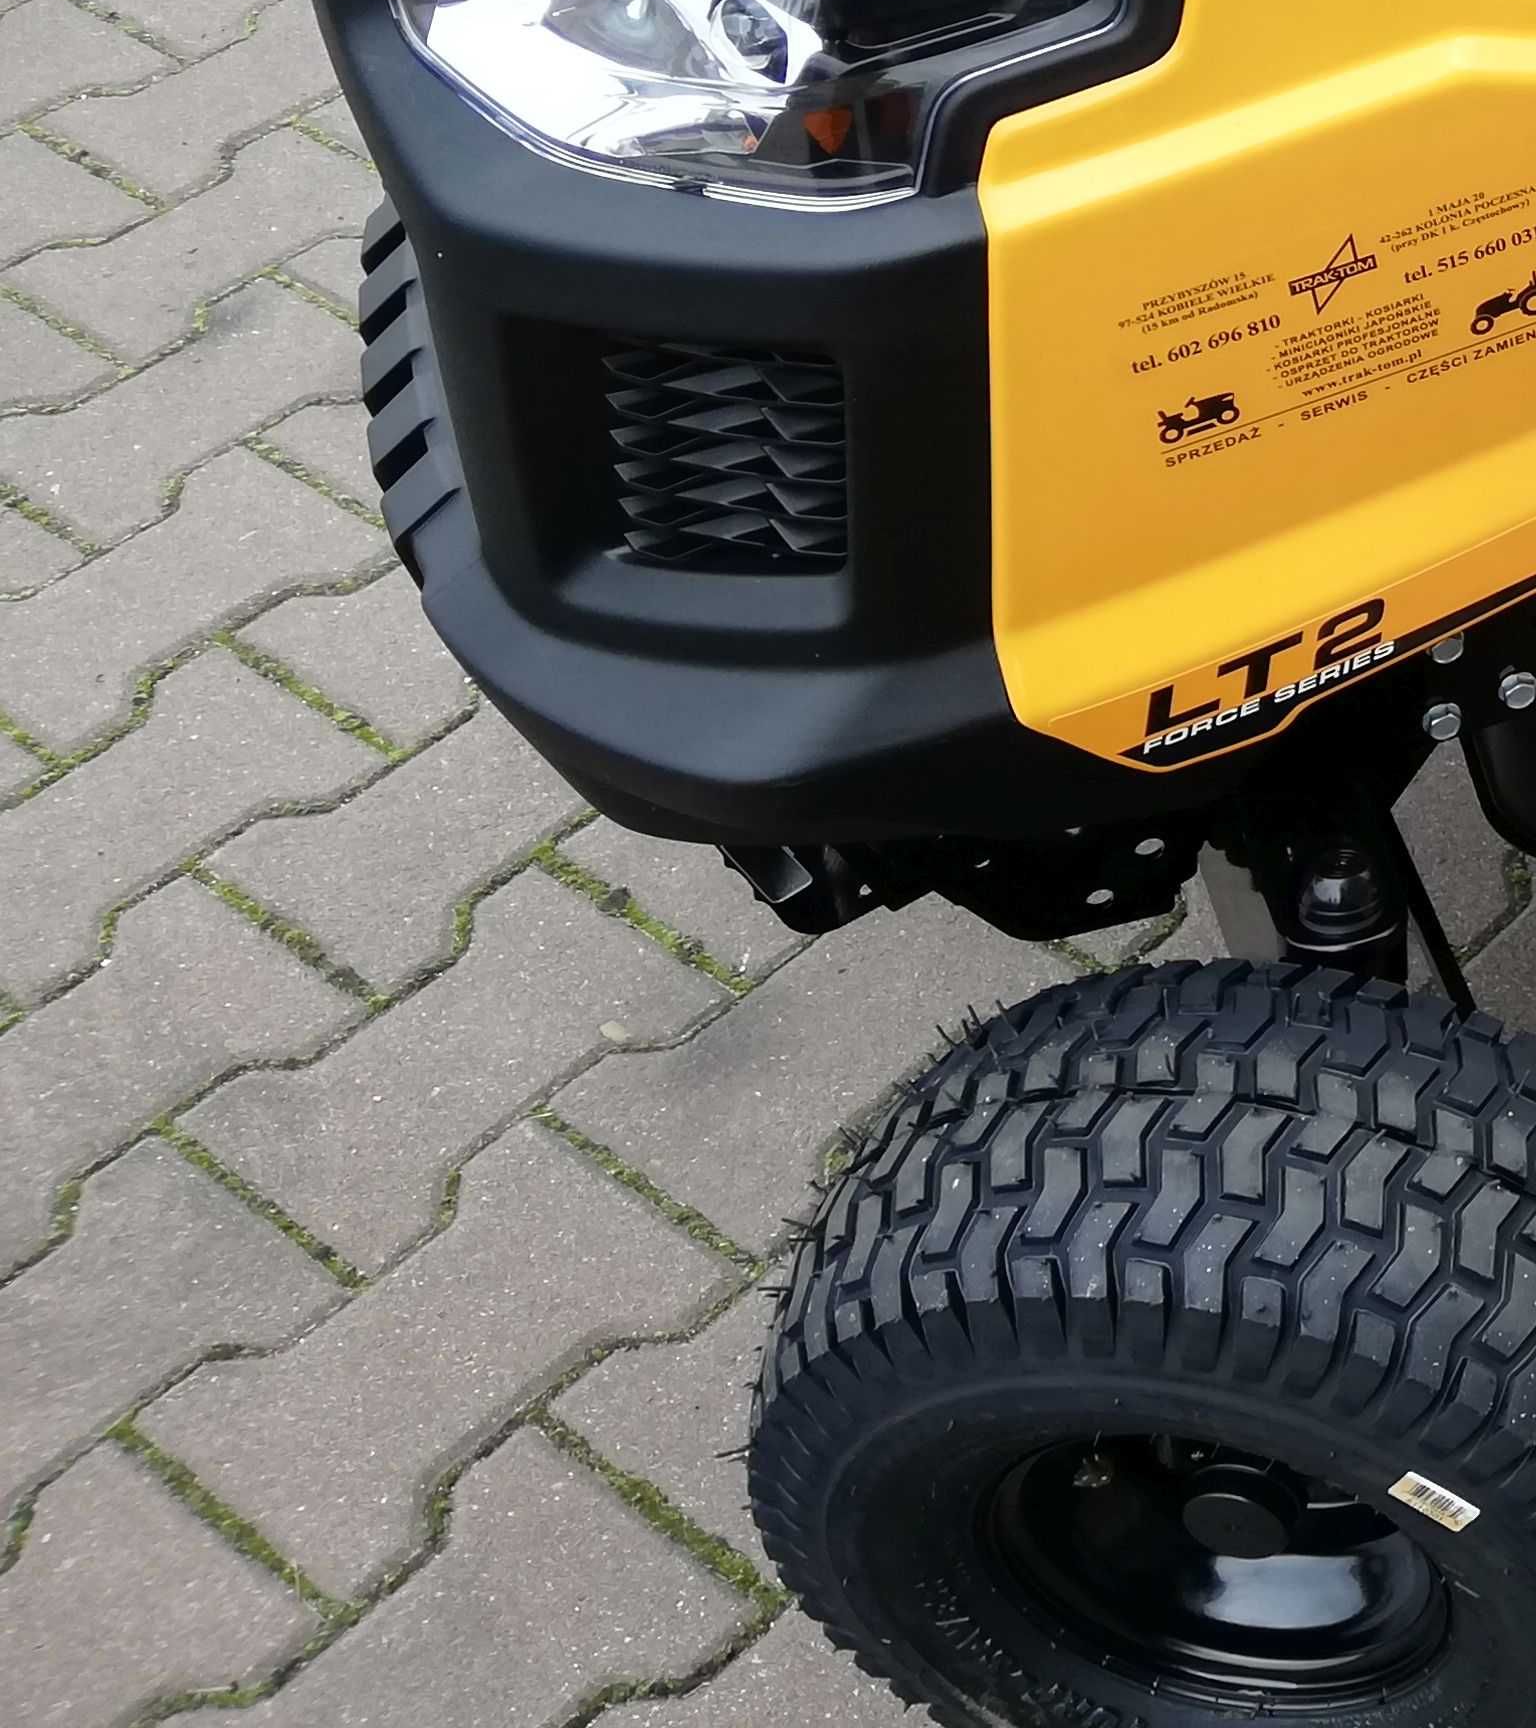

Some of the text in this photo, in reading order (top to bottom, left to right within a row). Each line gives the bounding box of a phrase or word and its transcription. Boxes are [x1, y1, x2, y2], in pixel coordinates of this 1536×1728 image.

[1415, 208, 1471, 232] KOLONIA
[1436, 198, 1471, 214] MAJA
[1472, 192, 1484, 202] 20
[1421, 229, 1439, 241] DK
[1290, 257, 1376, 294] TRAK-TOM
[1404, 265, 1432, 283] tel.
[1437, 250, 1468, 272] 515
[1474, 238, 1506, 259] 660
[1142, 272, 1246, 311] PRZYBYSZÓW 15
[1157, 293, 1214, 317] KOBIELE
[1216, 274, 1275, 296] WIELKIE
[1161, 317, 1179, 327] km
[1181, 310, 1195, 320] od
[1198, 291, 1258, 315] Radomska)
[1273, 308, 1440, 370] KOSIARKI PROFESJONALNE
[1279, 300, 1431, 358] MINICIĄGNIKI JAPOŃSKIE
[1282, 316, 1354, 346] TRAKTORKI
[1365, 293, 1424, 319] KOSIARKI
[1132, 315, 1280, 373] tel. 602 696 810
[1280, 318, 1439, 378] OSPRZĘT DO TRAKTORÓW
[1285, 328, 1438, 387] URZĄDZENIA OGRODOWE
[1302, 349, 1423, 396] www.trak-tom.pl
[1165, 427, 1261, 467] SPRZEDAŻ
[1301, 390, 1368, 420] SERWIS
[1405, 354, 1467, 383] CZĘŚCI
[1143, 640, 1396, 754] FORCE SERIES
